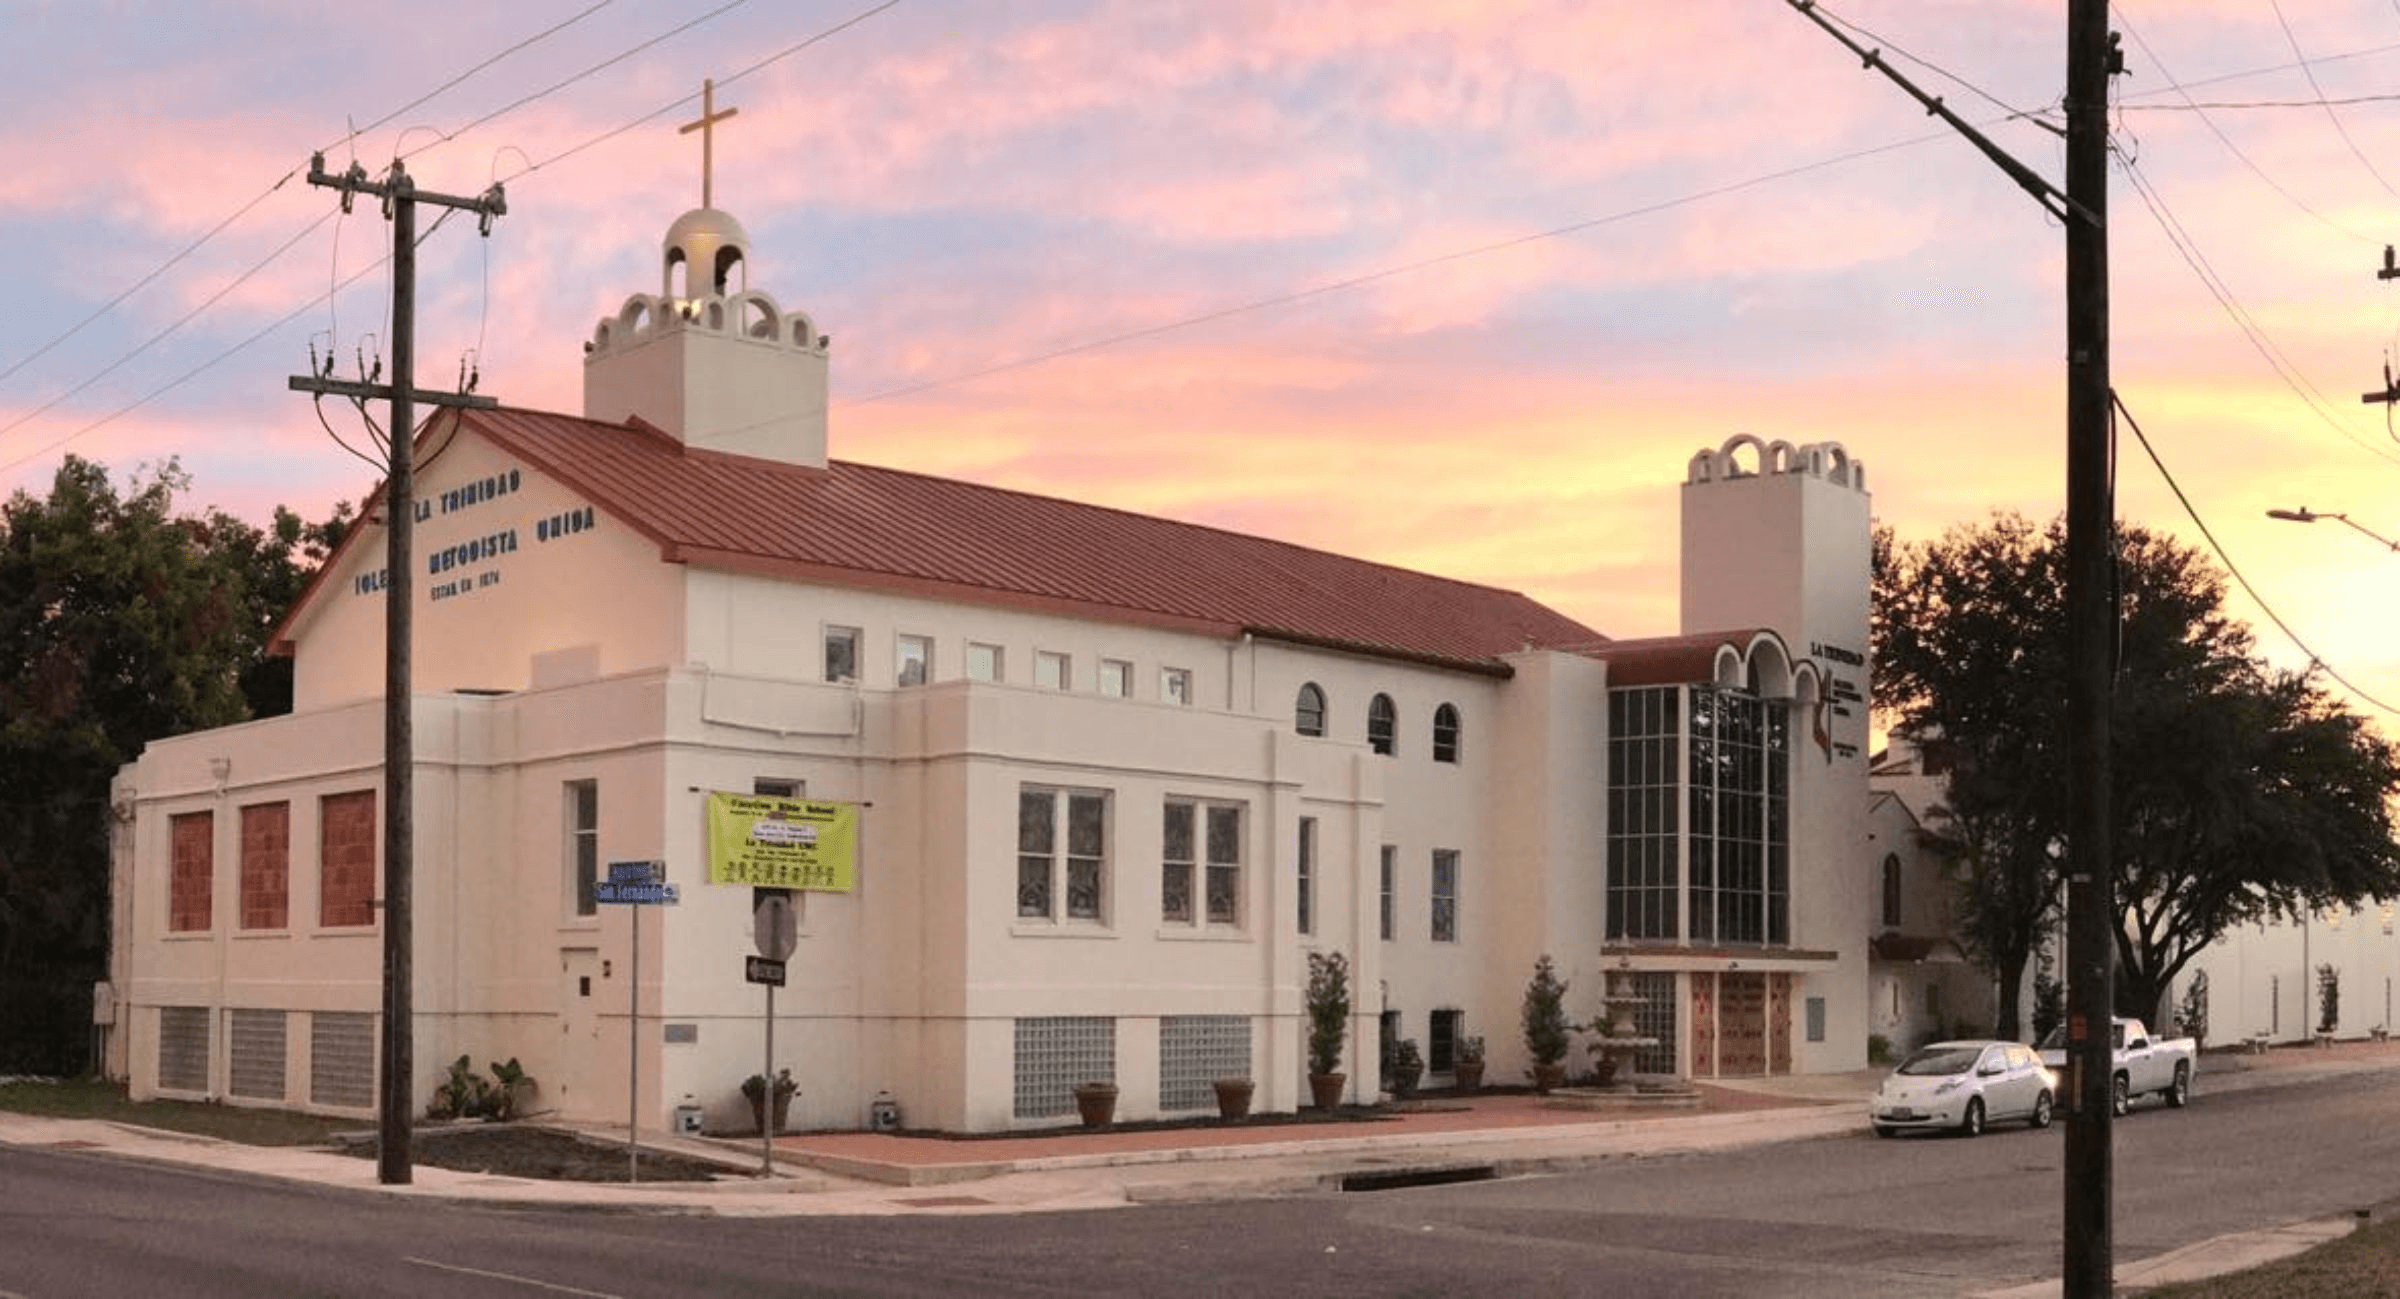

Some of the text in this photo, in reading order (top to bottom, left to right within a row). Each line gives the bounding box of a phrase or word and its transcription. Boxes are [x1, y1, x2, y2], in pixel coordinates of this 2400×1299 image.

[415, 468, 519, 523] LA TRINIDAD
[355, 506, 594, 596] IGLE METODISTA UNIDA
[1811, 641, 1823, 657] LA
